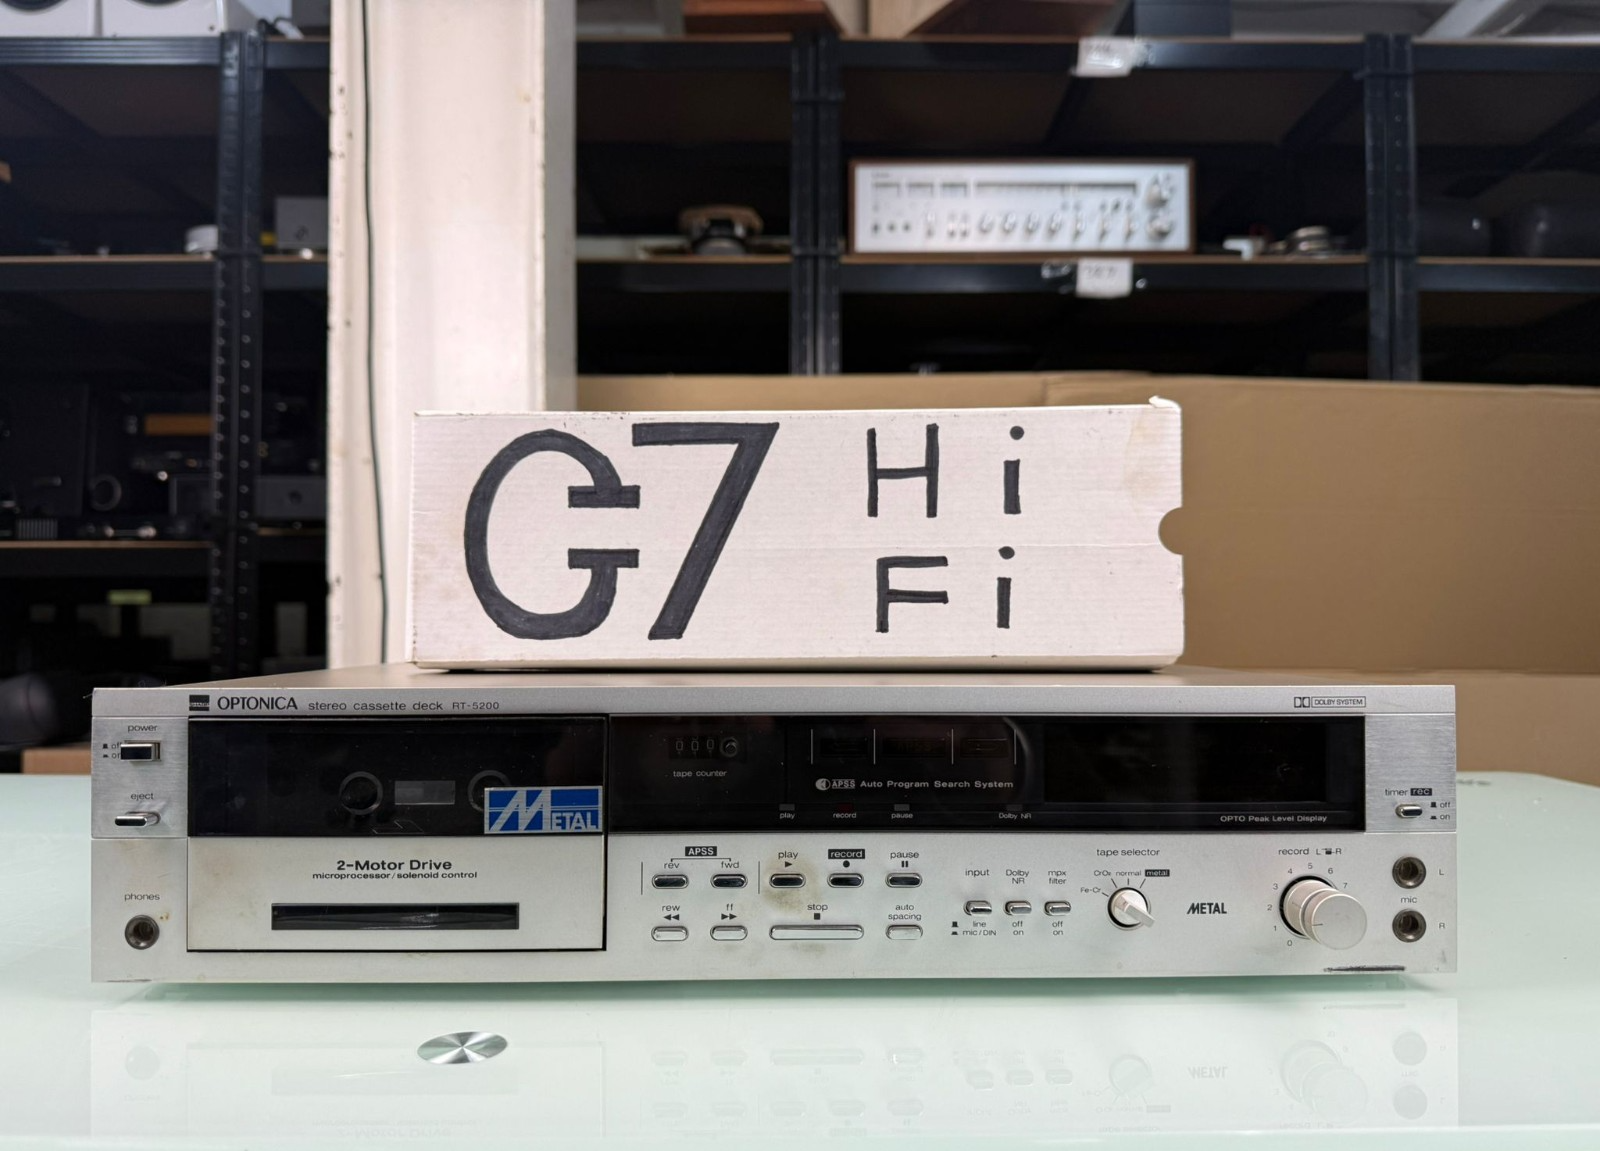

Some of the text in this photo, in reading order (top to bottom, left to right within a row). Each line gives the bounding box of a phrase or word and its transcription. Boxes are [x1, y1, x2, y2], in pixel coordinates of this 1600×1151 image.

[867, 424, 1025, 518] Hi
[464, 422, 780, 641] G7
[875, 546, 1016, 634] Fi
[217, 697, 299, 711] OPTONICA
[308, 701, 500, 711] stereo cassette deck RT-5200
[127, 723, 158, 734] power
[673, 770, 693, 779] tape
[831, 779, 1014, 790] APSS Auto Program Search System
[130, 790, 154, 801] eject
[1385, 787, 1431, 796] timer rec
[488, 790, 598, 832] METAL
[780, 811, 795, 820] play
[892, 812, 913, 820] pause
[999, 812, 1018, 820] Dolby
[1220, 814, 1327, 823] OPTO Peak Level Display
[688, 847, 714, 856] APSS
[778, 851, 798, 861] play
[831, 850, 863, 858] record
[890, 851, 920, 861] pause
[1096, 848, 1160, 858] tape selector
[1278, 847, 1310, 855] record
[337, 859, 452, 871] 2-Motor Drive
[721, 861, 740, 869] fwd
[1308, 862, 1313, 870] 5
[441, 871, 478, 879] control
[965, 868, 990, 878] input
[1006, 869, 1030, 879] Dolby
[1048, 870, 1067, 878] mpx
[1048, 877, 1067, 885] filter
[124, 892, 160, 902] phones
[1400, 896, 1417, 904] mic
[726, 903, 734, 911] ff
[807, 903, 829, 913] stop
[1187, 902, 1228, 914] METAL
[888, 911, 922, 922] spacing
[1287, 939, 1292, 947] 0
